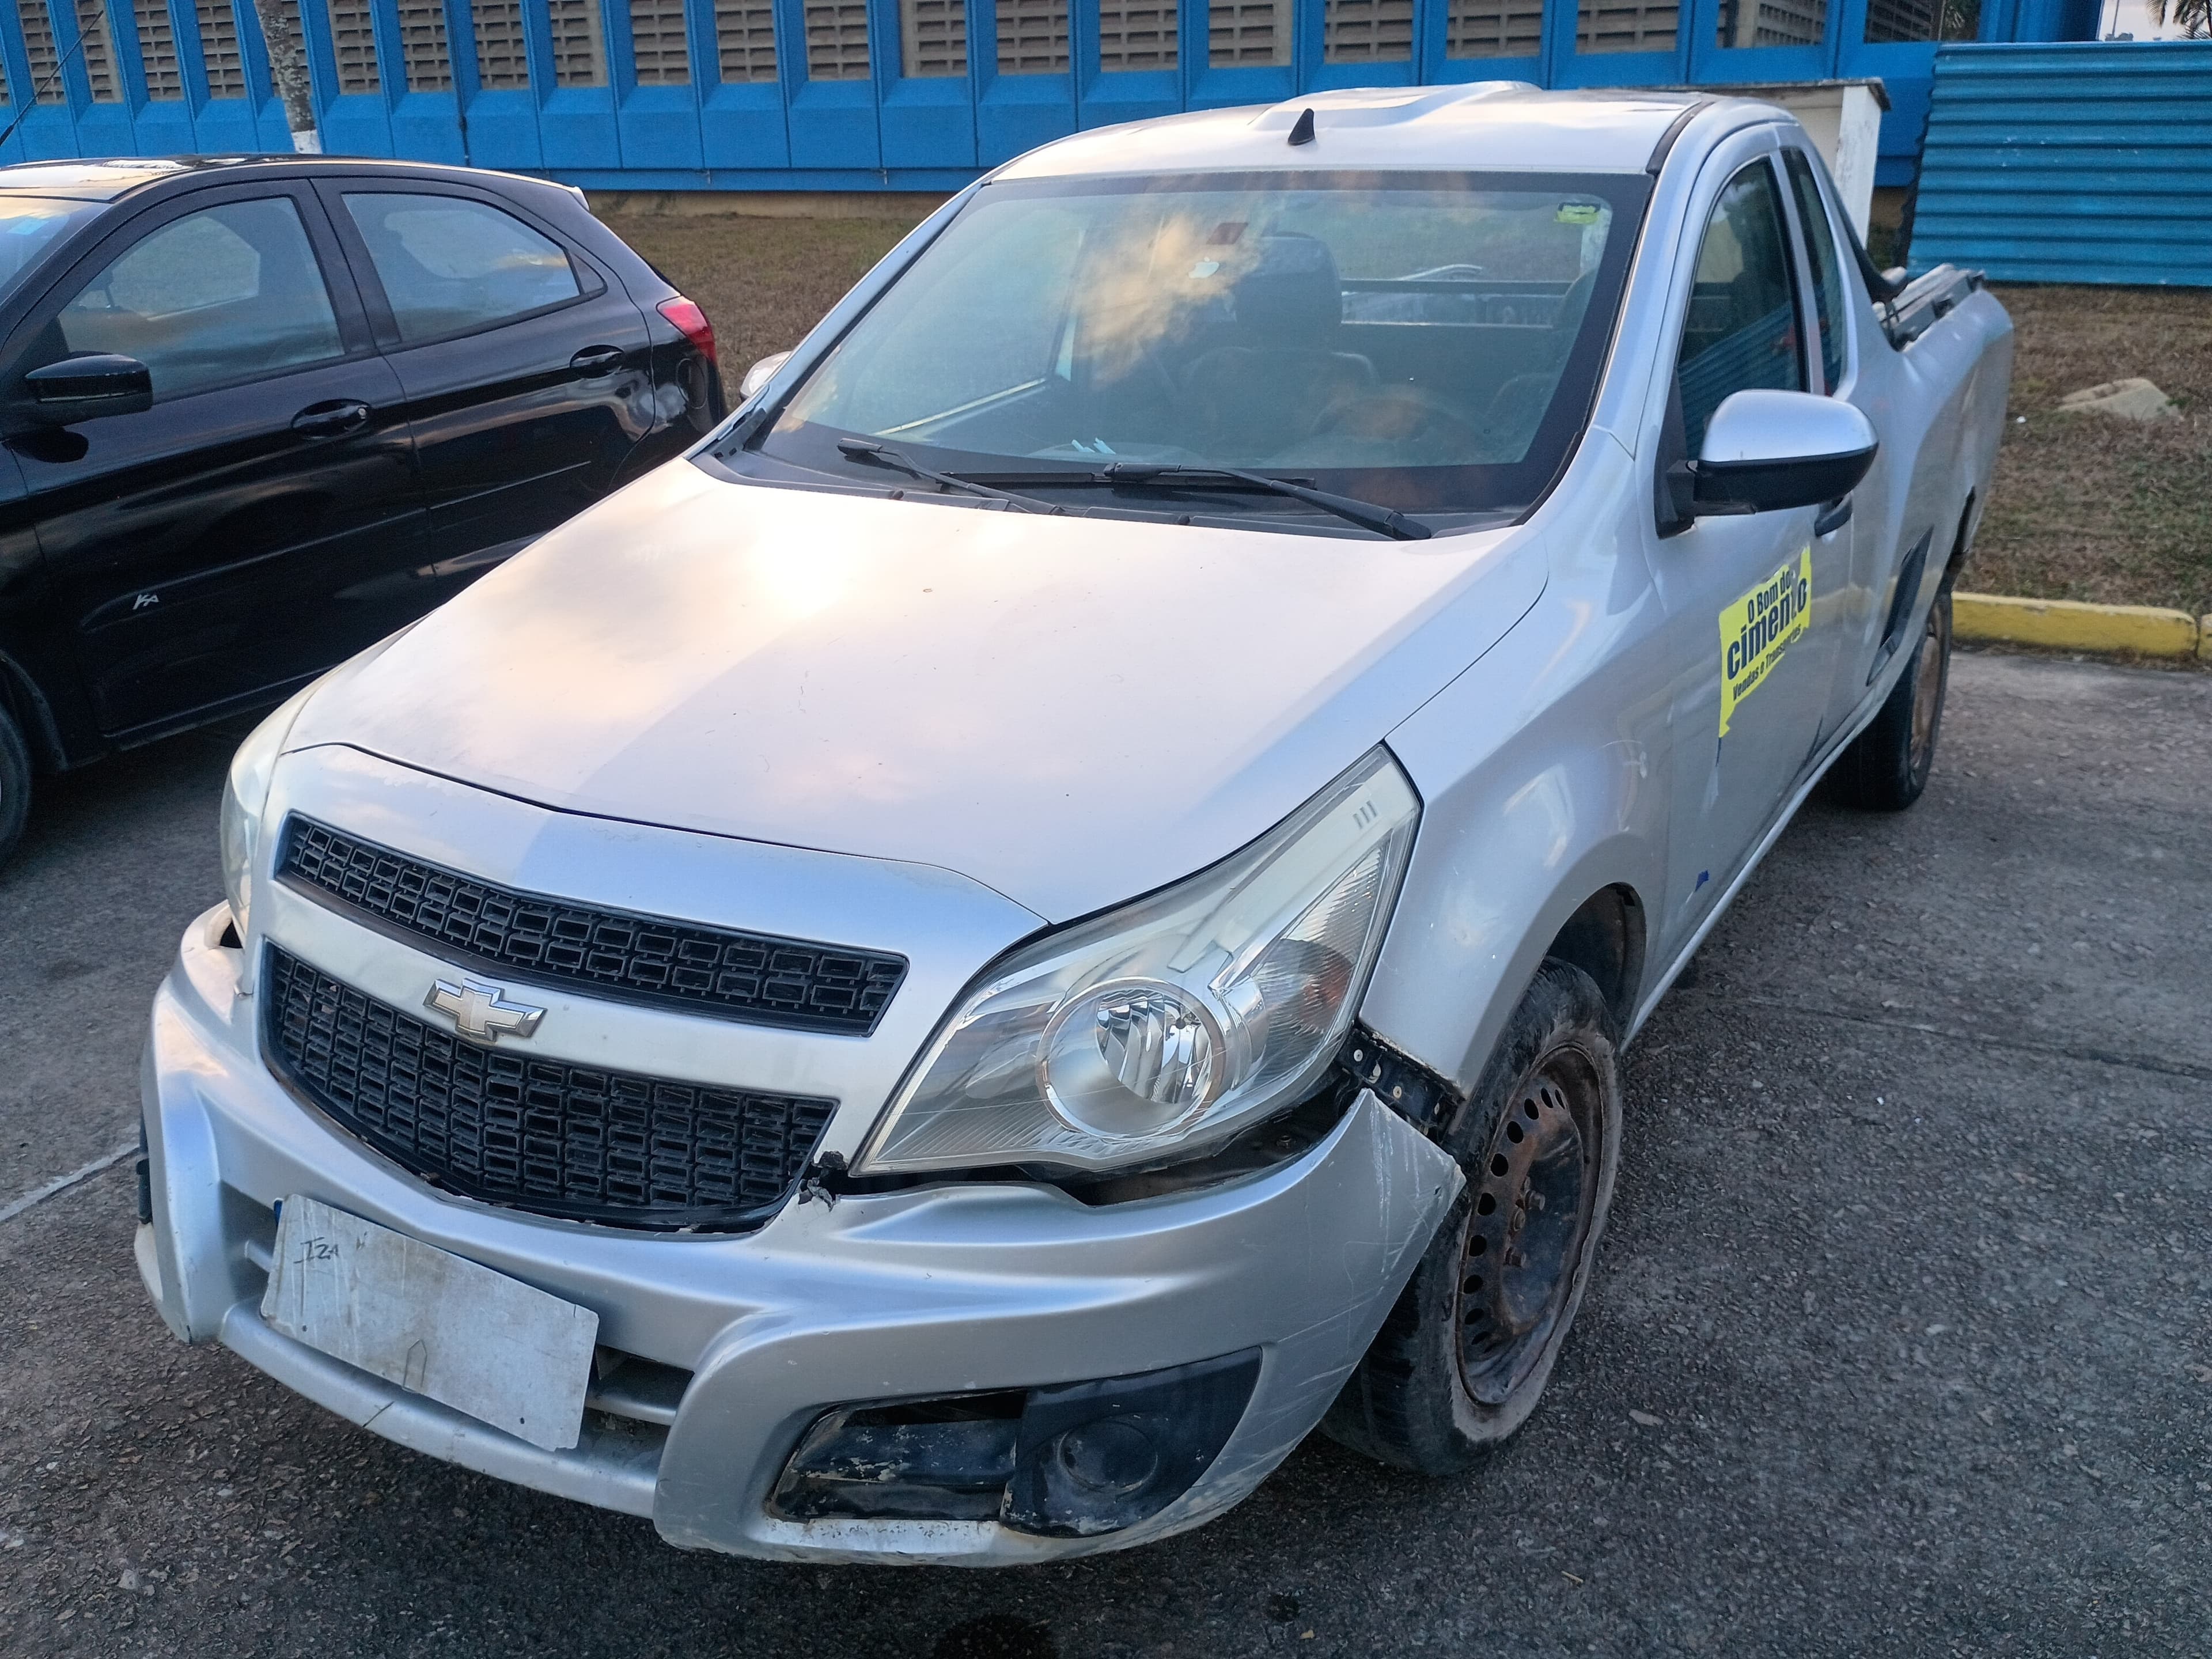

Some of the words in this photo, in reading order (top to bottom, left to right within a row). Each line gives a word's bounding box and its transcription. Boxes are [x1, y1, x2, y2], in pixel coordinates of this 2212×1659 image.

[1748, 599, 1754, 624] O
[1756, 582, 1778, 617] Bom
[1733, 666, 1759, 701] Vendas
[1760, 661, 1764, 675] e
